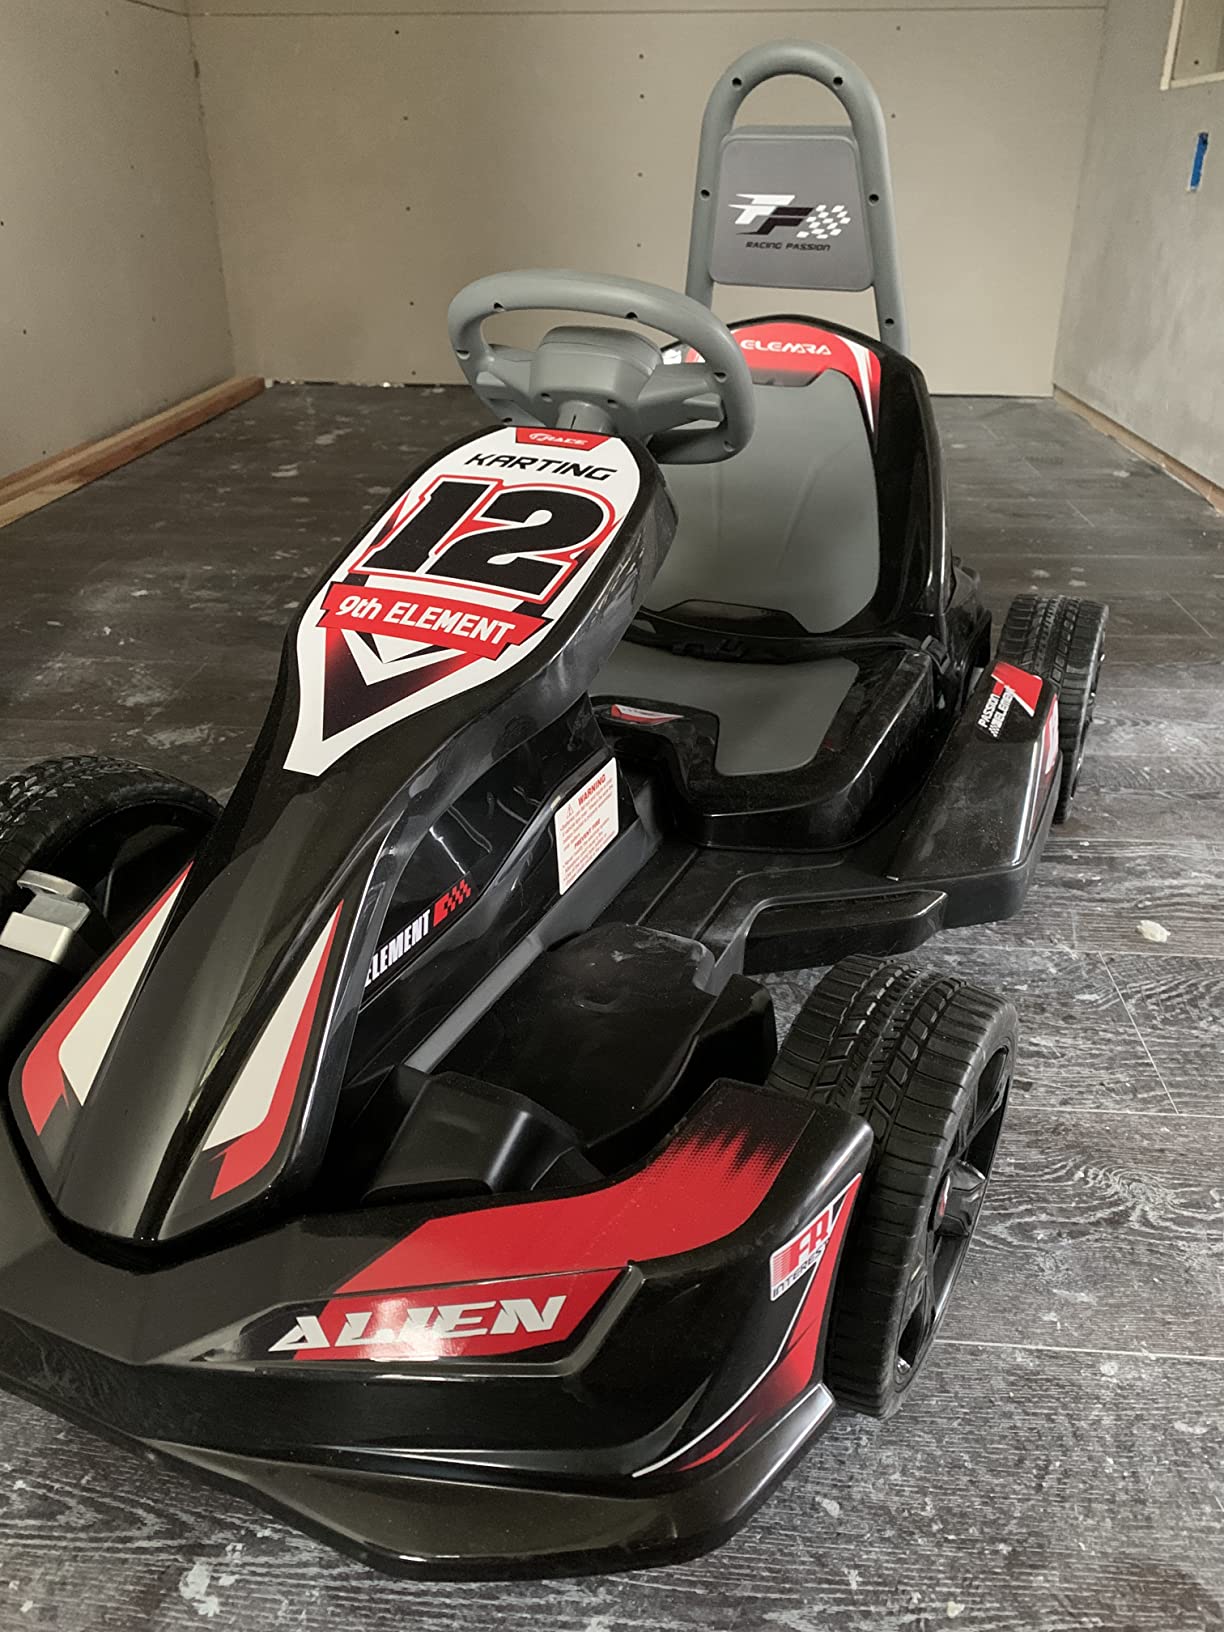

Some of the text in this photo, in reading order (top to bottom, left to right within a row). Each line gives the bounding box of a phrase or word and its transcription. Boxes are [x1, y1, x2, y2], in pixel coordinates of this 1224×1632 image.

[464, 453, 618, 481] KARTING
[361, 480, 604, 596] 12
[336, 595, 516, 645] 9th ELEMENT
[578, 774, 606, 806] WARNING
[268, 1295, 567, 1352] ALIEN
